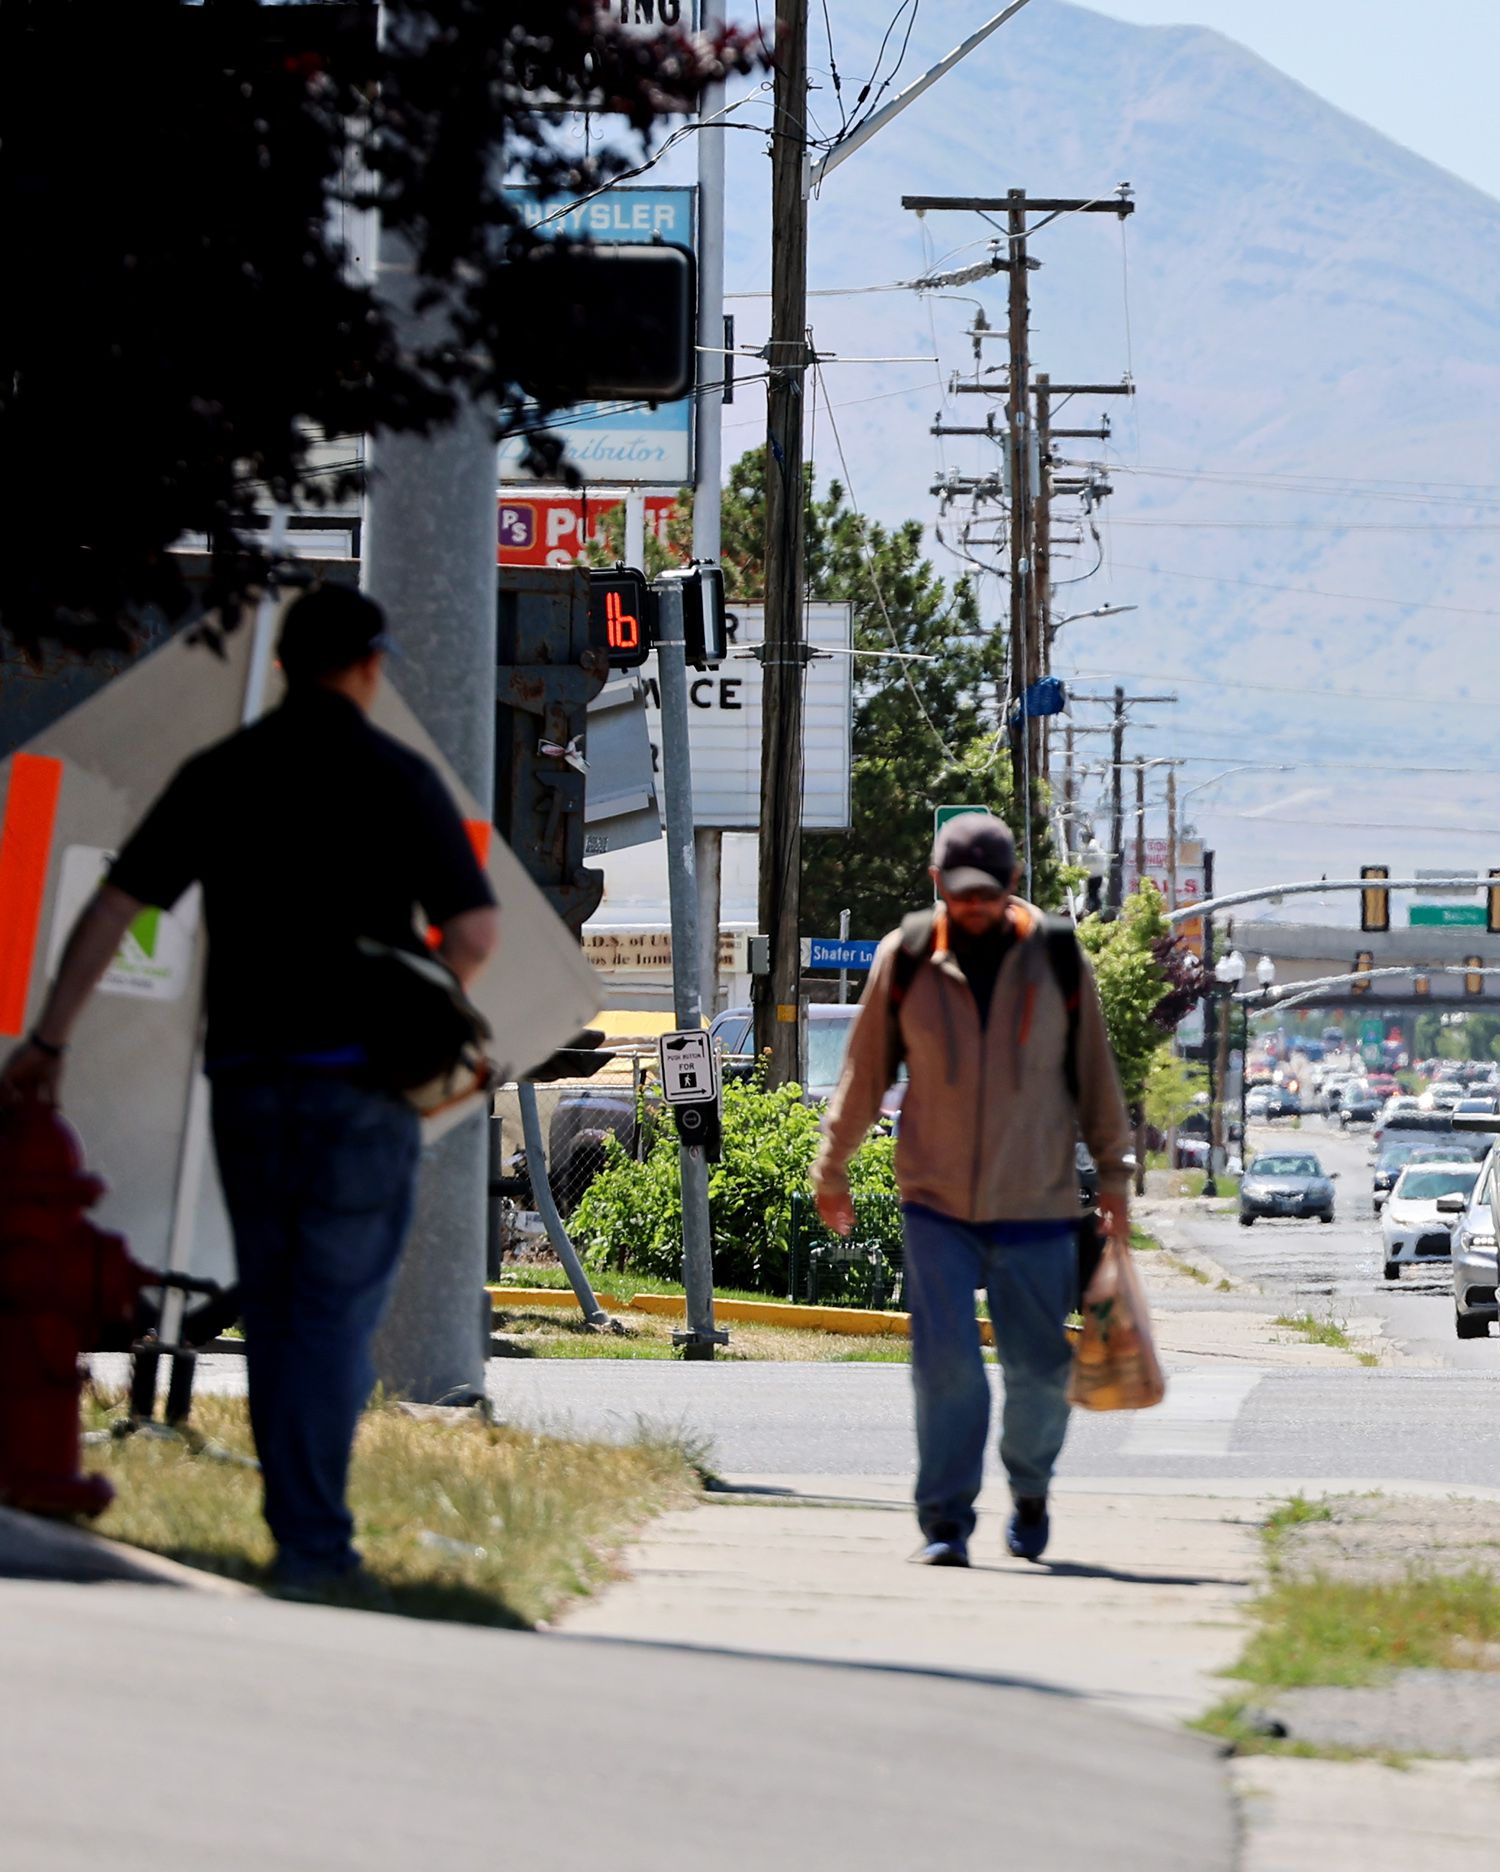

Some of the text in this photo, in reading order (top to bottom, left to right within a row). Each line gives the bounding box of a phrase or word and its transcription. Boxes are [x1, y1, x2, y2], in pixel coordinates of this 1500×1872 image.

[619, 0, 680, 26] ING
[630, 934, 644, 947] of
[813, 945, 873, 962] Shafer Ln
[678, 1062, 695, 1071] FOR
